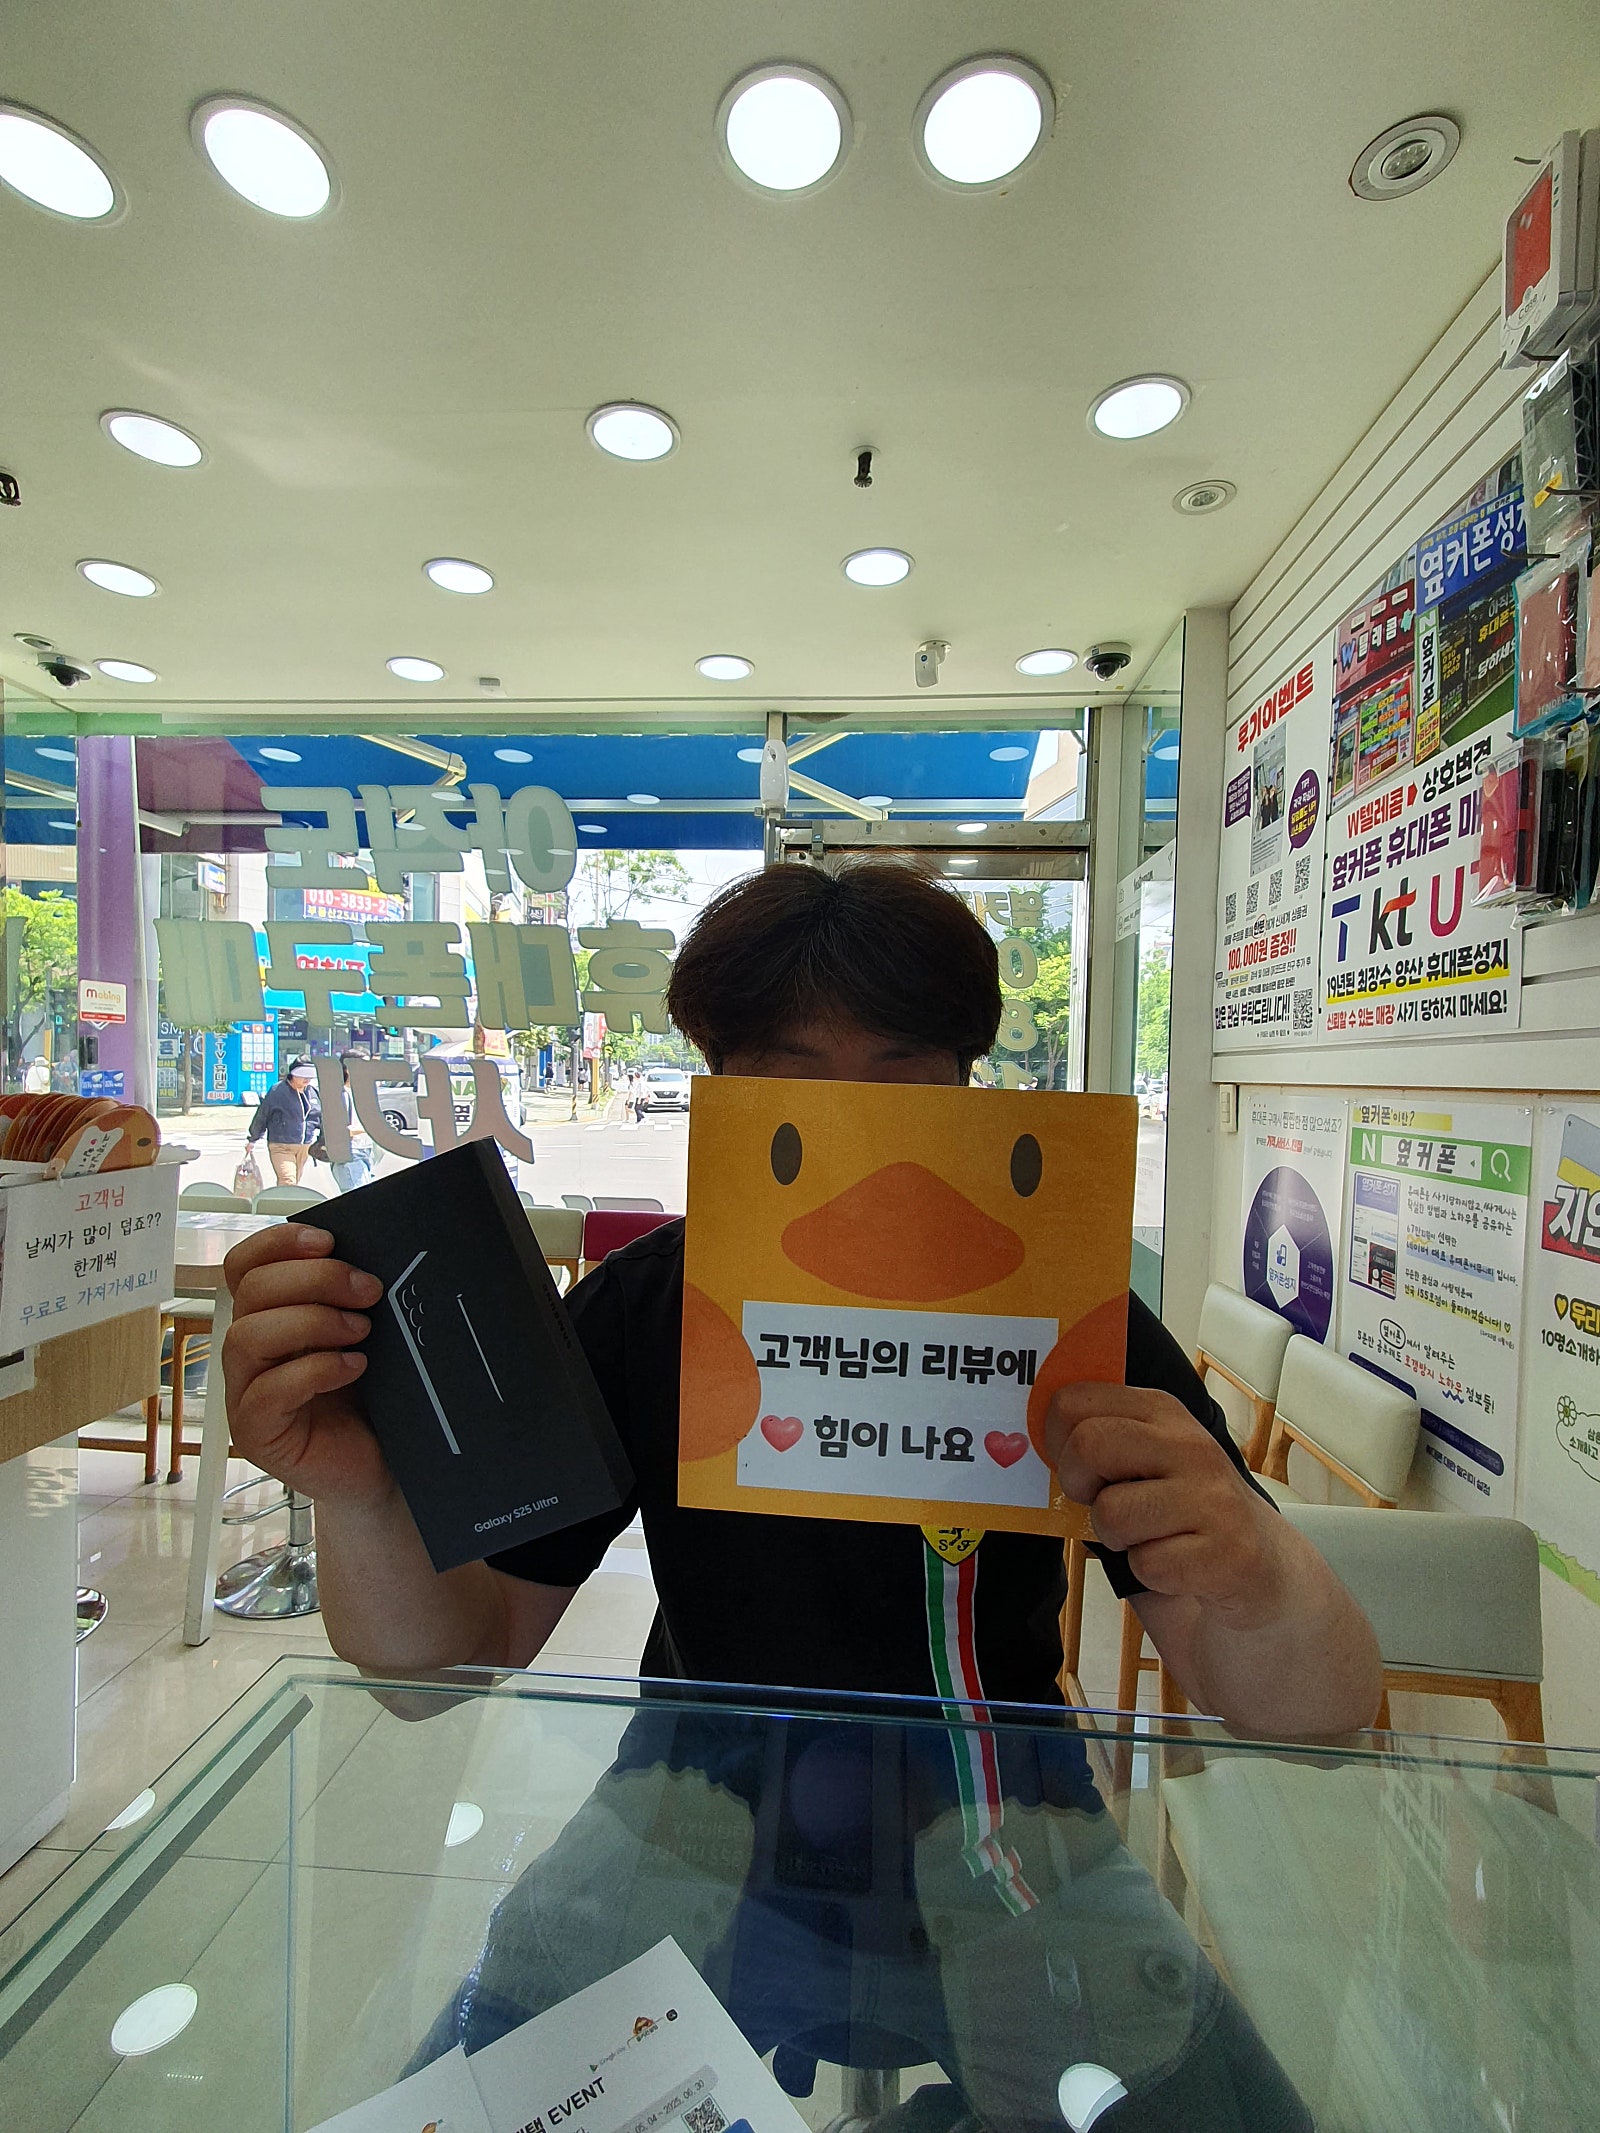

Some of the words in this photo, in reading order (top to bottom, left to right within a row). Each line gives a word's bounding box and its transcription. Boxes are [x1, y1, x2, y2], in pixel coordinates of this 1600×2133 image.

[1237, 662, 1315, 753] 후기이벤트
[1347, 787, 1404, 840] W텔레콤
[1332, 836, 1383, 892] 옆커폰
[1386, 802, 1452, 869] 휴대폰
[1331, 894, 1362, 963] T
[1369, 876, 1418, 955] kt
[1228, 938, 1268, 972] 100,000원
[1327, 971, 1355, 999] 19년된
[1357, 963, 1392, 993] 최장수
[1395, 956, 1424, 988] 양산
[1426, 938, 1509, 983] 휴대폰성지
[1227, 1002, 1240, 1028] 관심
[1348, 1010, 1357, 1027] 수
[1357, 1007, 1374, 1028] 있는
[1375, 1003, 1395, 1027] 매장
[1396, 1000, 1420, 1023] 사기
[1420, 995, 1457, 1022] 당하지
[1459, 989, 1508, 1018] 마세요!
[1309, 1115, 1343, 1133] 많으셨죠?
[1361, 1132, 1377, 1162] N
[75, 1187, 125, 1212] 고객님
[26, 1230, 74, 1259] 날씨가
[83, 1222, 112, 1246] 많이
[120, 1211, 162, 1236] 덥죠??
[1482, 1216, 1513, 1236] 공유하는
[73, 1250, 118, 1278] 한개씩
[19, 1296, 69, 1326] 무료로
[77, 1269, 159, 1306] 가져가세요!!
[756, 1332, 910, 1379] 고객님의
[921, 1343, 1038, 1386] 리뷰에
[1423, 1344, 1456, 1370] 알려주는
[1438, 1372, 1464, 1394] 노하우
[1465, 1386, 1495, 1415] 정보들!
[814, 1415, 889, 1459] 힘이
[901, 1425, 976, 1463] 나요
[474, 1512, 513, 1535] Galaxy
[512, 1503, 533, 1521] S25
[531, 1495, 560, 1513] Ultra
[546, 2076, 606, 2126] EVENT
[693, 2079, 705, 2092] 30
